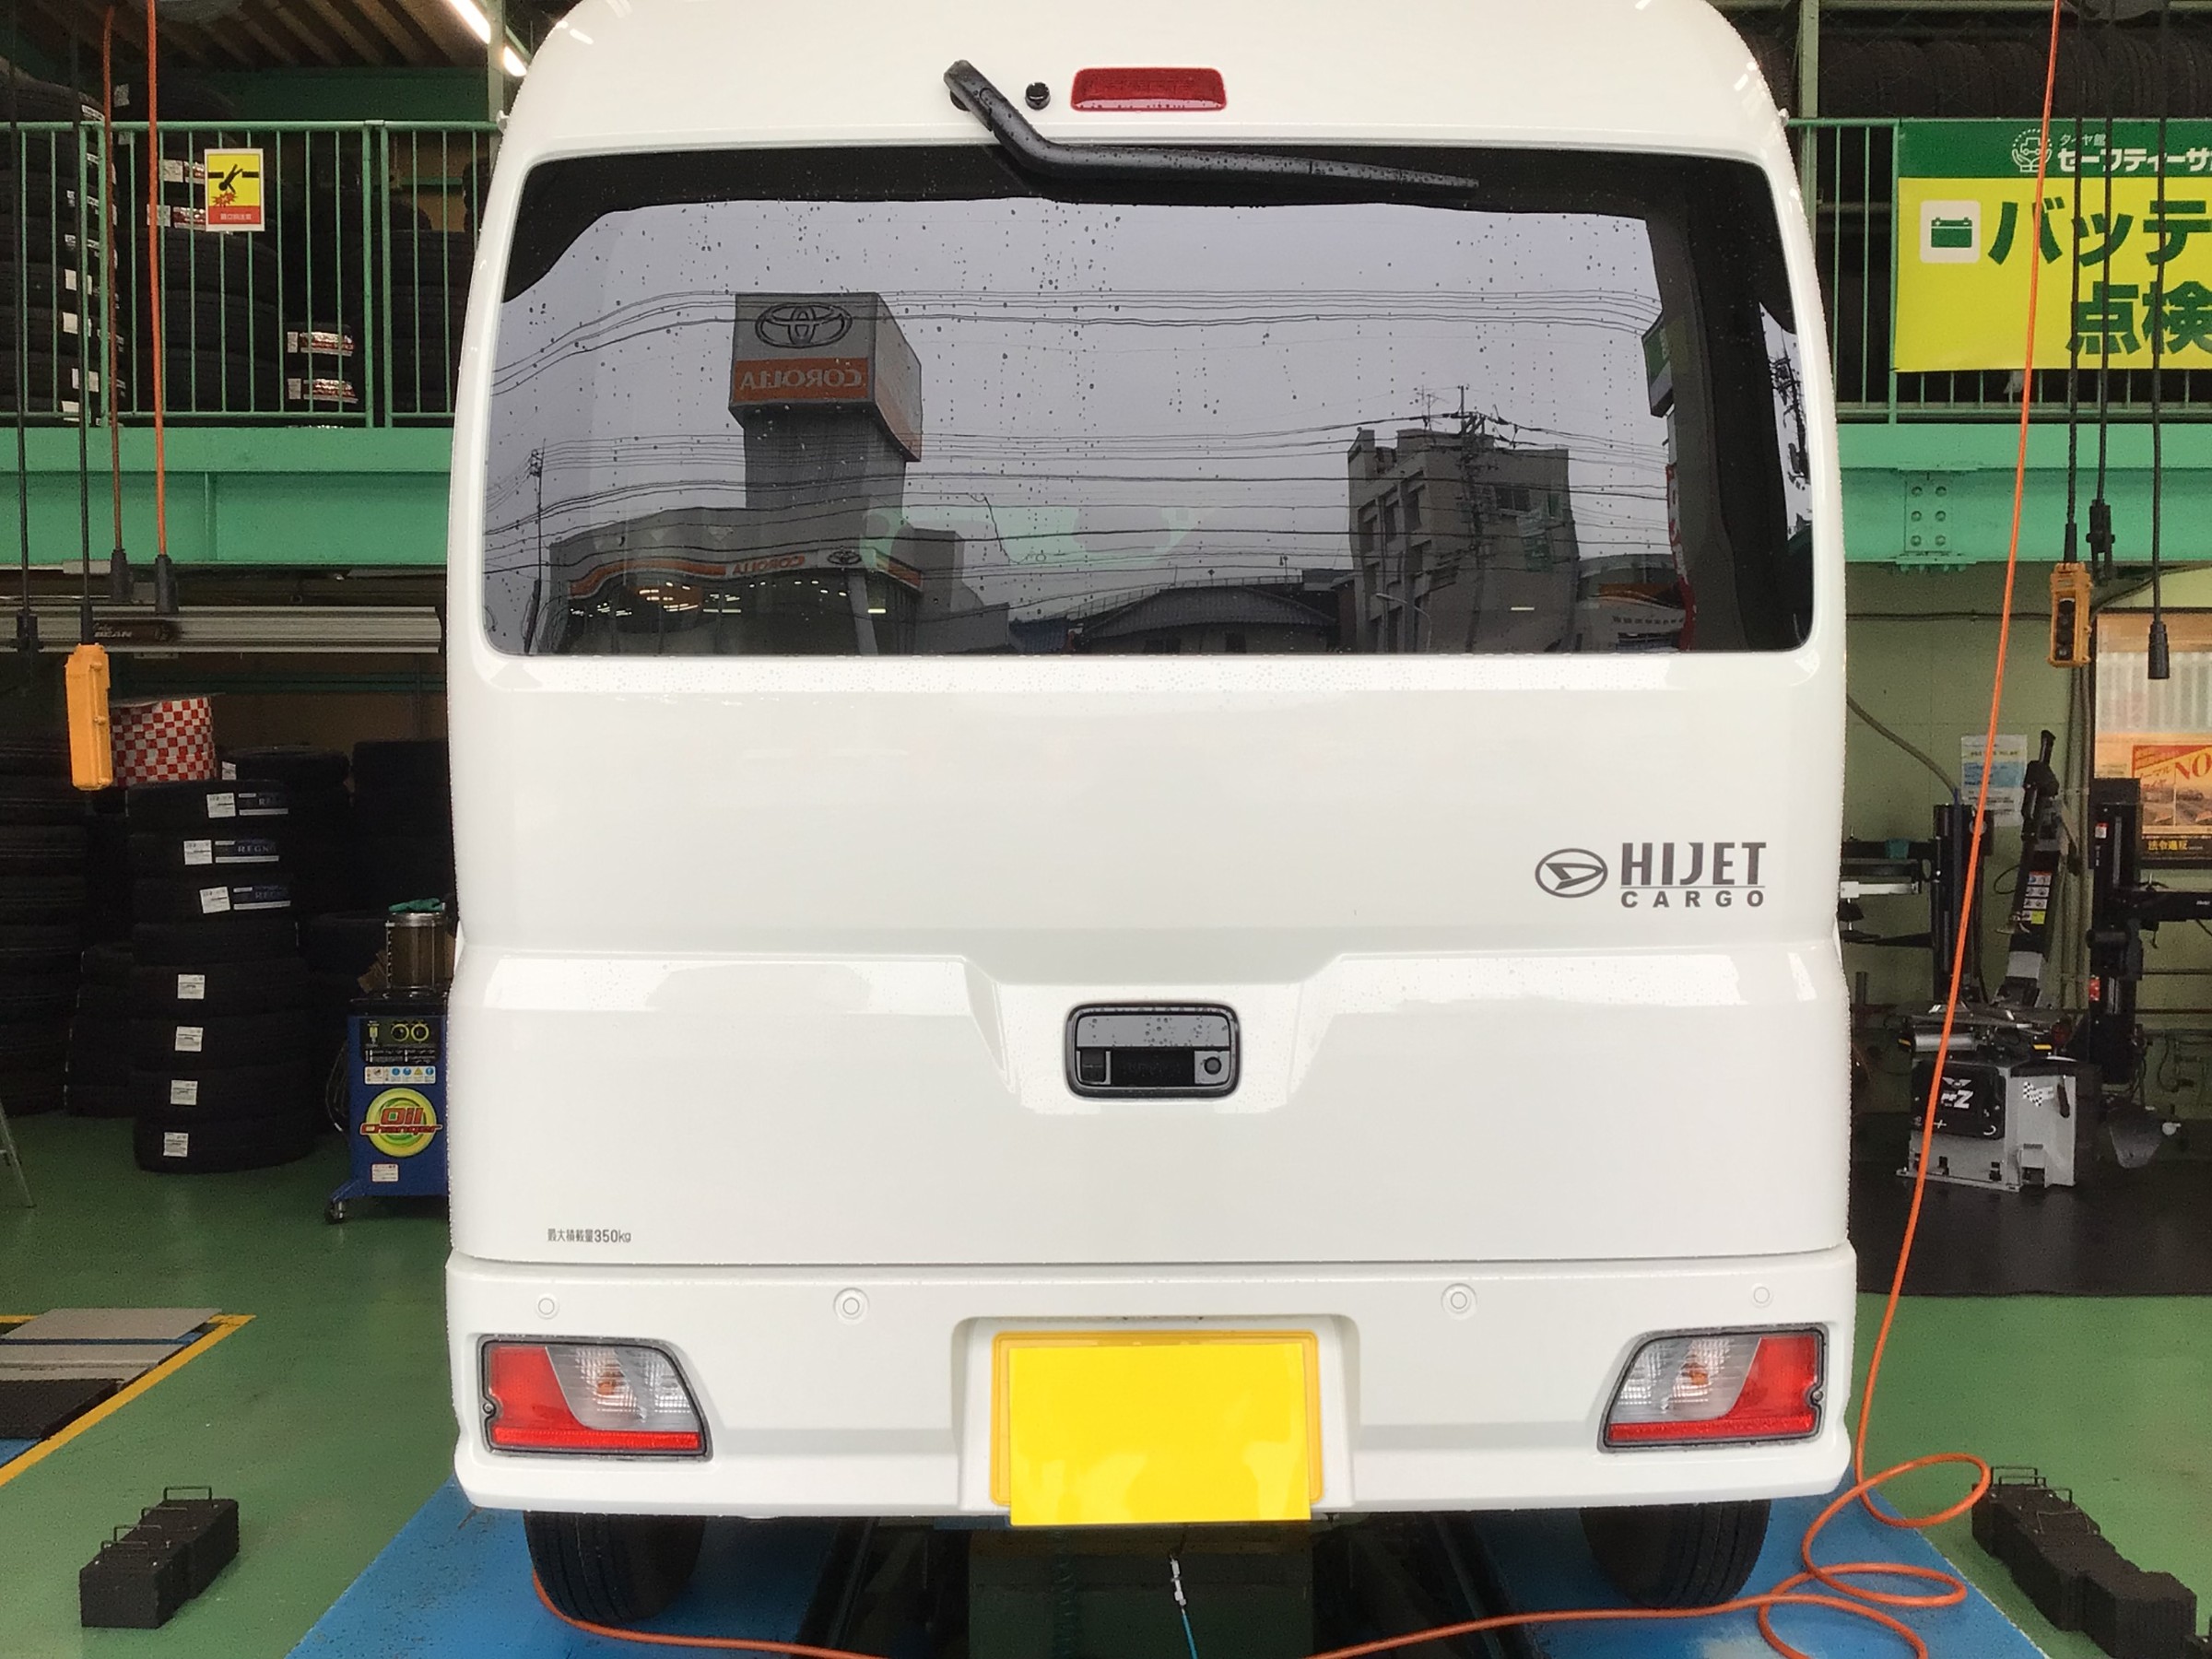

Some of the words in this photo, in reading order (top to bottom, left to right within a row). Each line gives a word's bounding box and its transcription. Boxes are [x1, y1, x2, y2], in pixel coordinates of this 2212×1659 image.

[2057, 147, 2212, 172] セーフティーサ
[1987, 196, 2212, 267] バッテ
[2065, 280, 2212, 355] 点検
[1620, 841, 1767, 886] HIJET
[1620, 889, 1764, 909] CARGO
